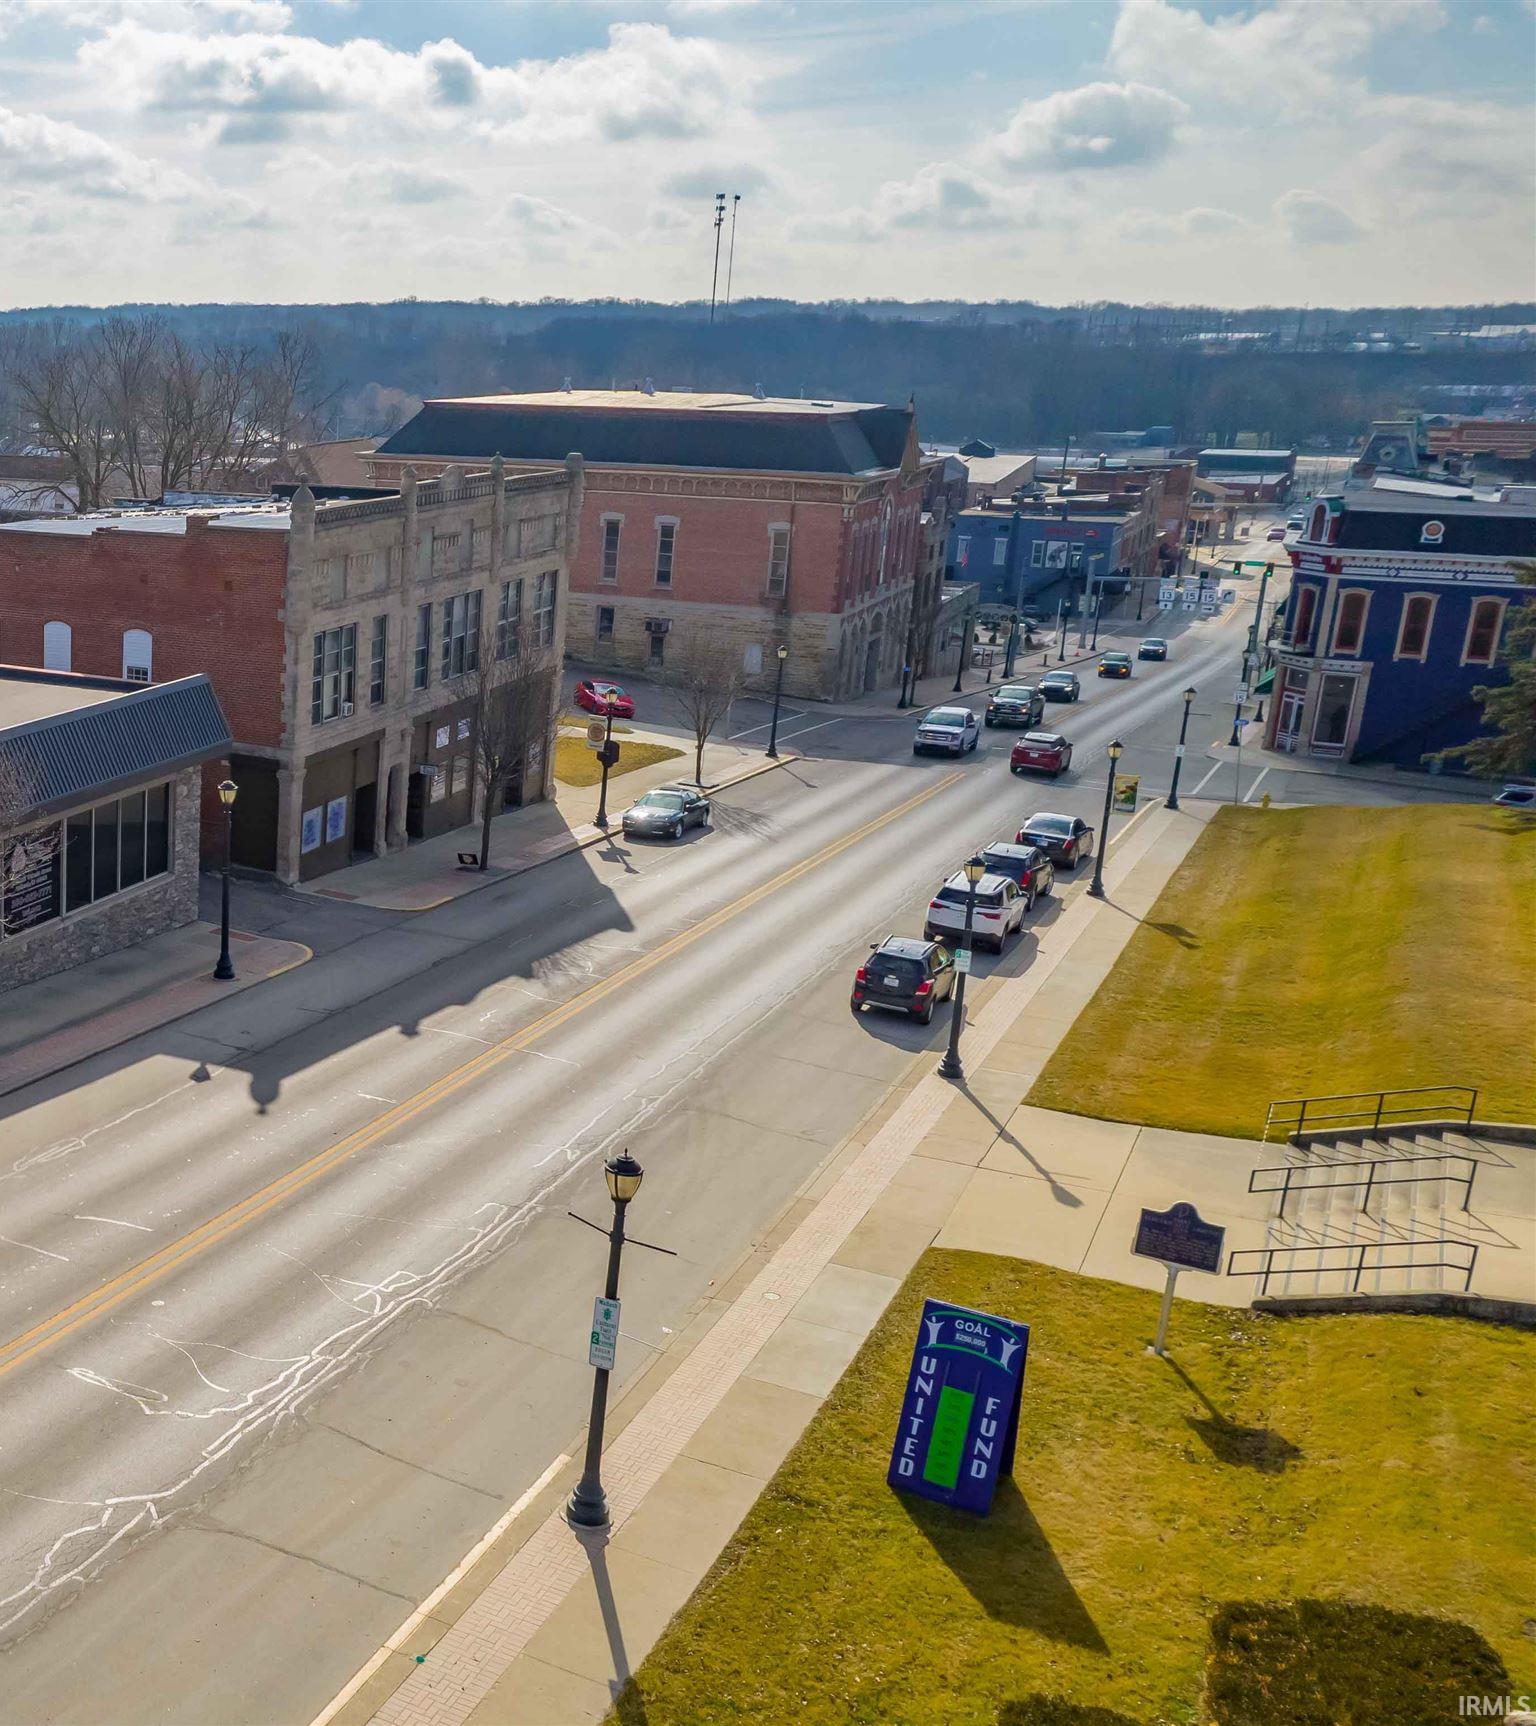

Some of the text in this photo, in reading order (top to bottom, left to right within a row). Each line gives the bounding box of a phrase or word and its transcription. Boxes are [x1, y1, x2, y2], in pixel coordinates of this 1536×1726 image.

[1162, 591, 1172, 599] 13
[955, 1319, 992, 1338] GOAL
[897, 1355, 938, 1477] UNITED
[970, 1396, 1001, 1480] FUND
